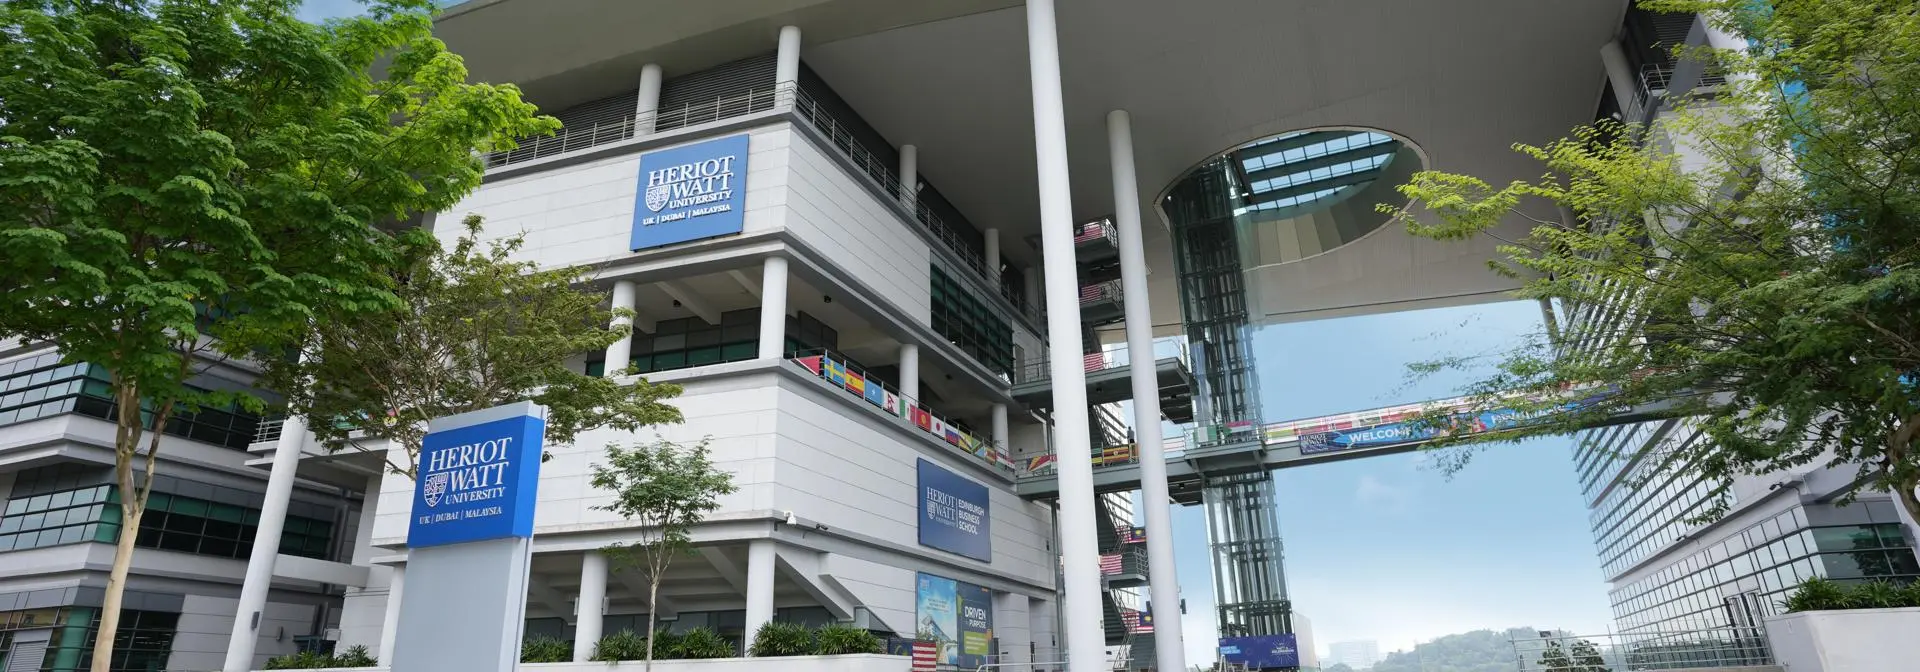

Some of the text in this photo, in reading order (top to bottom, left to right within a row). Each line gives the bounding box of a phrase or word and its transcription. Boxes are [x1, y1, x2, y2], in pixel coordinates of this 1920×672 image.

[648, 155, 735, 188] HERIOT
[672, 173, 734, 199] WATT
[669, 190, 733, 209] UNIVERSITY
[643, 204, 731, 225] UK DUBAI MALAYSIA
[428, 437, 513, 472] HERIOT
[450, 462, 509, 492] WATT
[445, 487, 506, 505] UNIVERSITY
[926, 486, 956, 508] HERIOT
[419, 506, 502, 524] UK DUBAI MALAYSIA
[935, 502, 956, 520] WATT
[958, 499, 985, 516] EDINBURGH
[959, 509, 980, 525] BUSINESS
[959, 520, 978, 535] SCHOOL
[964, 606, 986, 620] DRIVEN
[969, 619, 987, 629] PURPOSE
